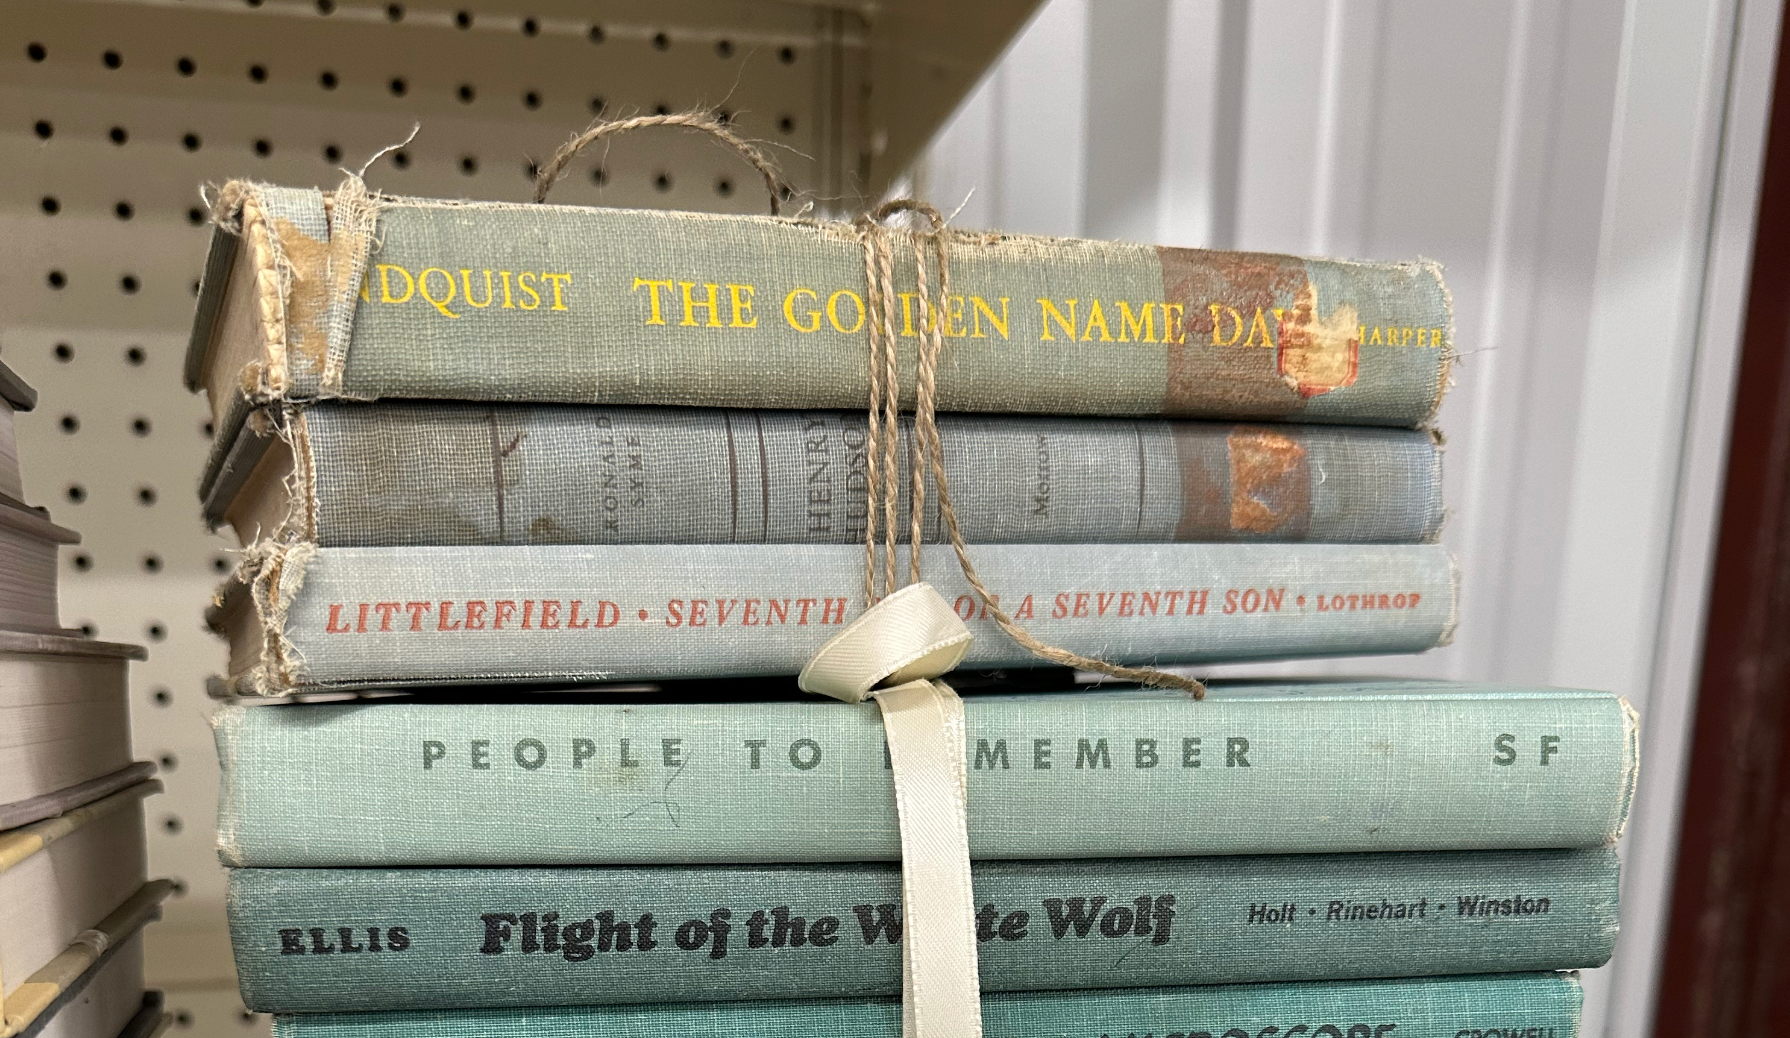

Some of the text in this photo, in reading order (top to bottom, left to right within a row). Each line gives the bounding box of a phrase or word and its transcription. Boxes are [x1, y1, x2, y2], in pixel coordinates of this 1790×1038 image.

[360, 264, 573, 318] DQUIST
[633, 279, 758, 327] THE
[783, 288, 1011, 341] GODEN
[1040, 299, 1186, 344] NAME
[1209, 304, 1284, 347] DA
[596, 415, 618, 533] RONALD
[626, 436, 644, 508] SYME
[804, 417, 832, 533] HENRY
[843, 415, 869, 543] HUDSO
[325, 600, 621, 634] LITTLEFIELD
[665, 597, 848, 628] SEVENTH
[1014, 594, 1034, 620] A
[1052, 591, 1209, 621] SEVENTH
[1222, 588, 1285, 615] SON
[1316, 591, 1421, 613] LOTHROP
[422, 737, 685, 771] PEOPLE
[744, 737, 823, 771] TO
[884, 736, 1251, 770] MEMBER
[280, 894, 1549, 962] ELLIS Flight of the Wte Wolf Holt Rinehart Winston
